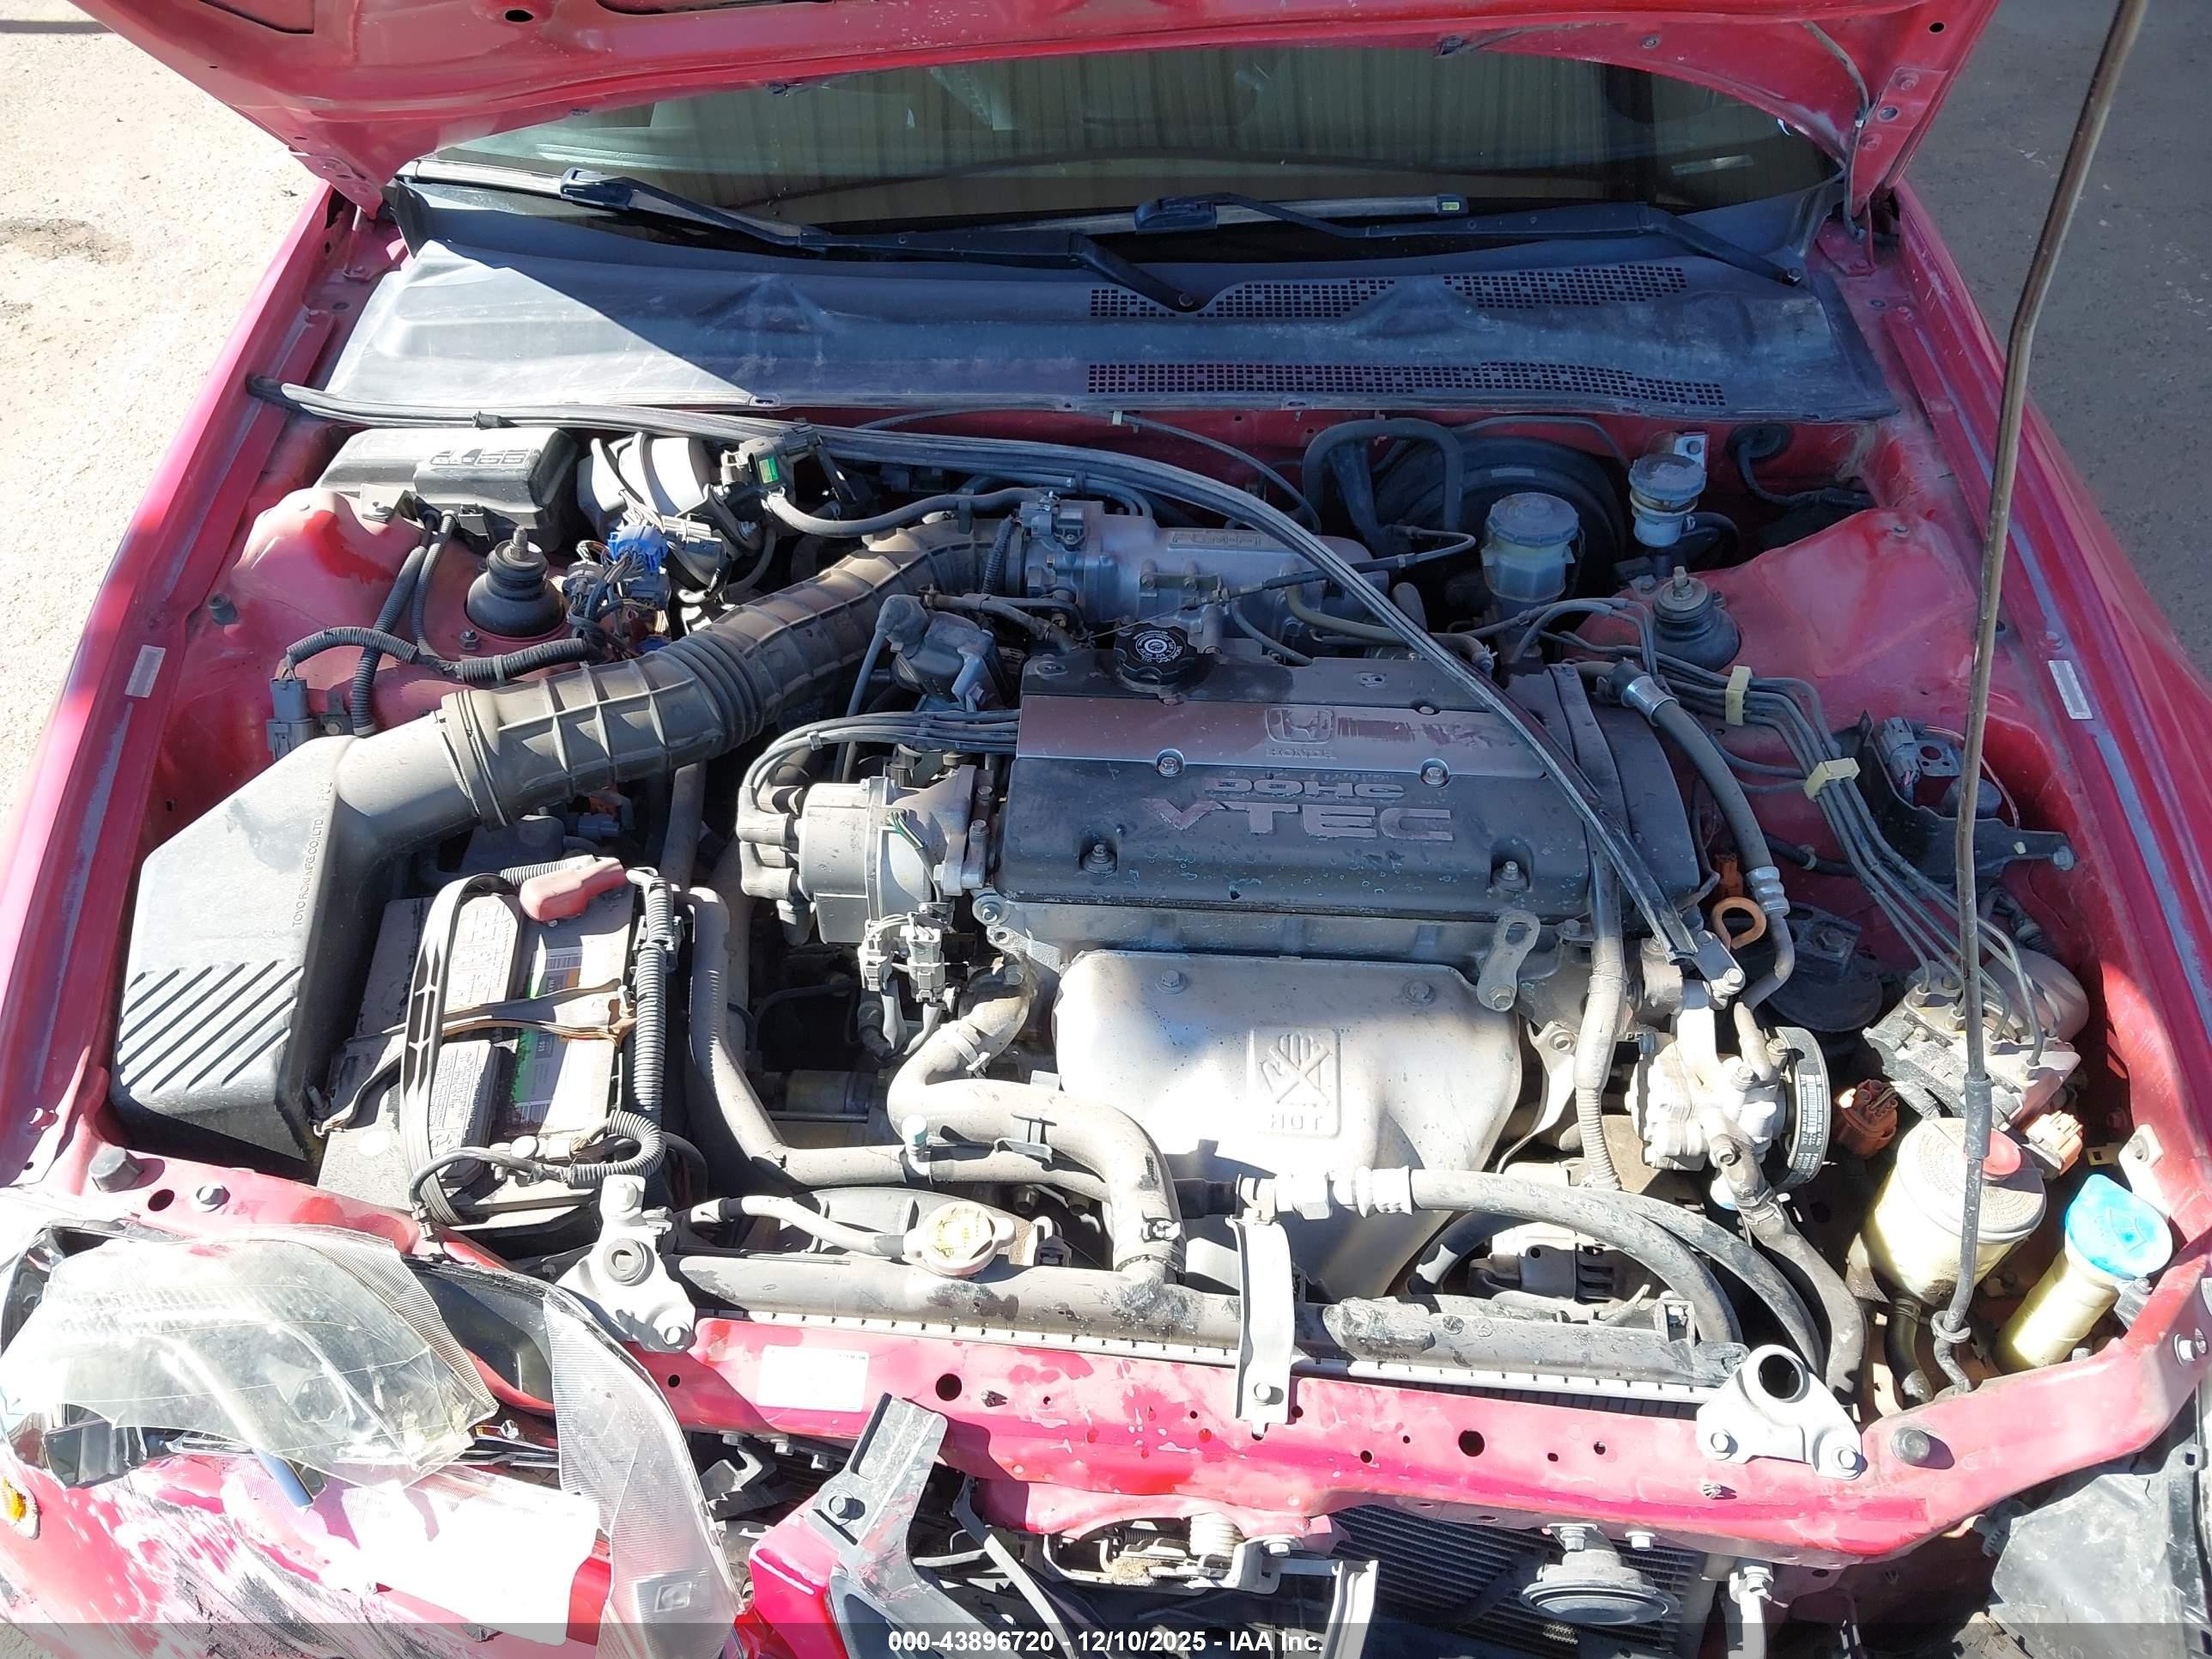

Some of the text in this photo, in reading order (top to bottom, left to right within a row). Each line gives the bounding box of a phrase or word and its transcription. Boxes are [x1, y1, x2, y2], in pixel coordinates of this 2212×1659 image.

[1266, 748, 1338, 760] HONDA
[1204, 777, 1407, 799] DOHC
[1141, 797, 1455, 842] VTEC
[1271, 1113, 1327, 1132] HOT
